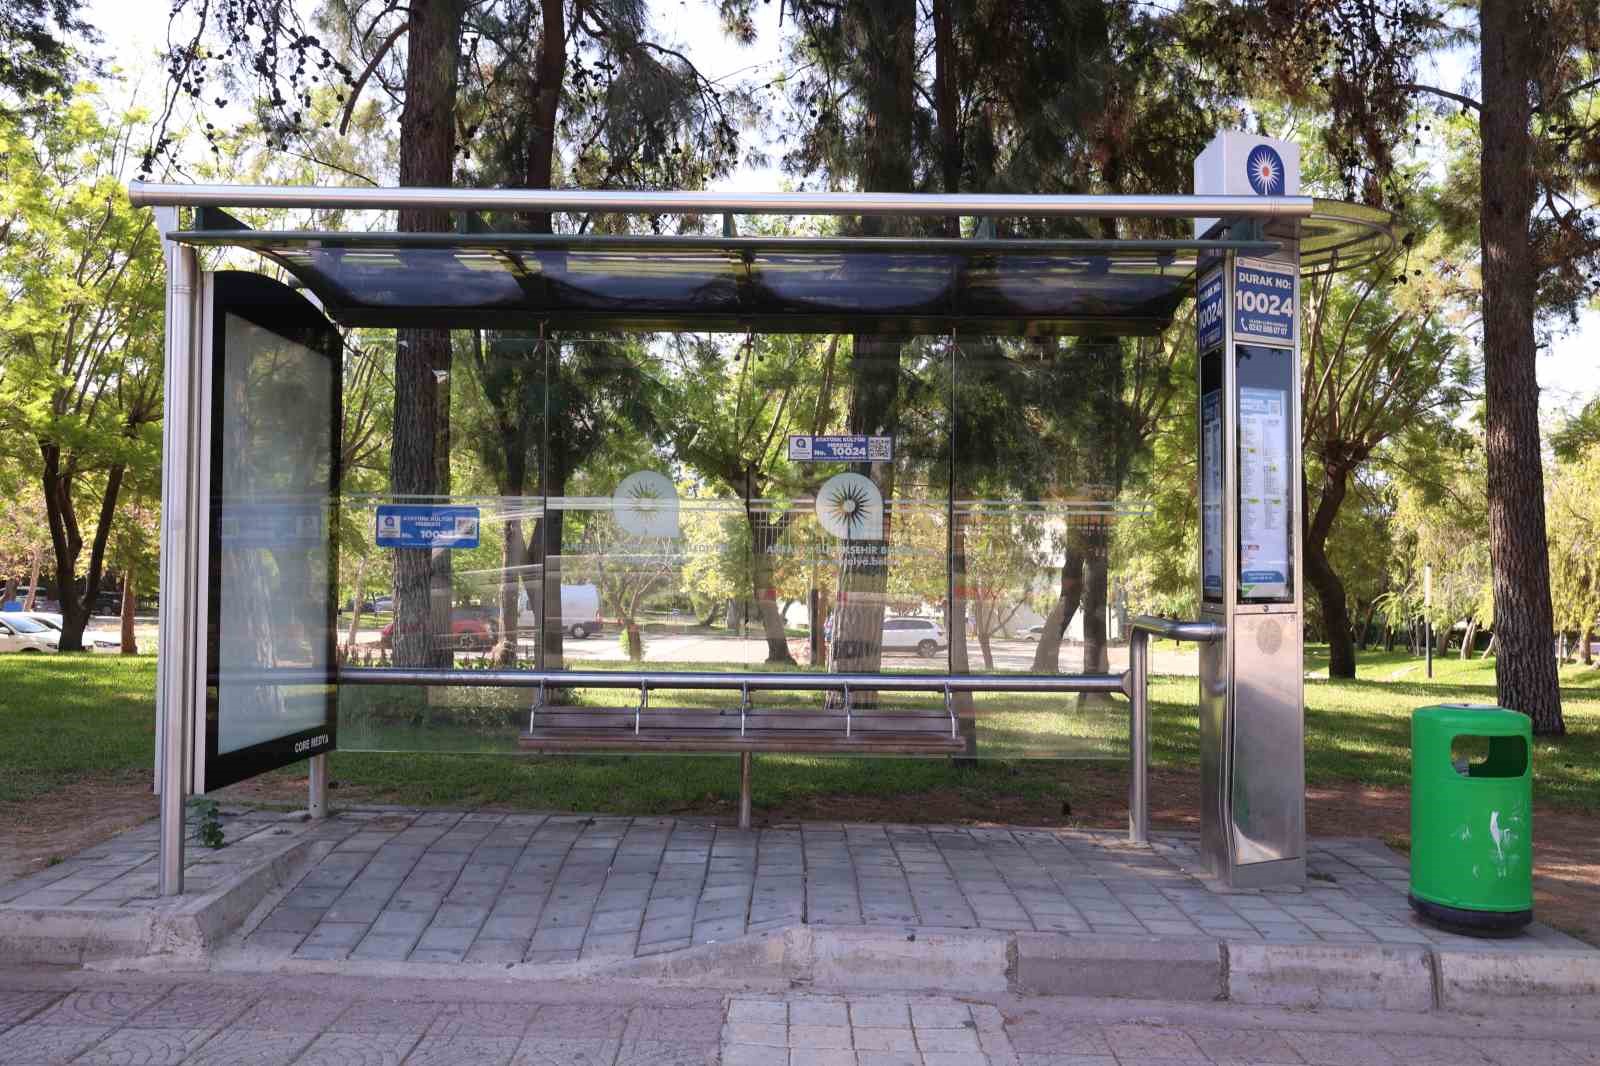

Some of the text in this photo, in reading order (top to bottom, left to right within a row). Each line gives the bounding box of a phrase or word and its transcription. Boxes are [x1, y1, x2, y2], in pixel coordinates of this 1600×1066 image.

[1239, 272, 1292, 289] DURAK NO:
[1236, 289, 1294, 319] 10024
[832, 447, 866, 456] 10024
